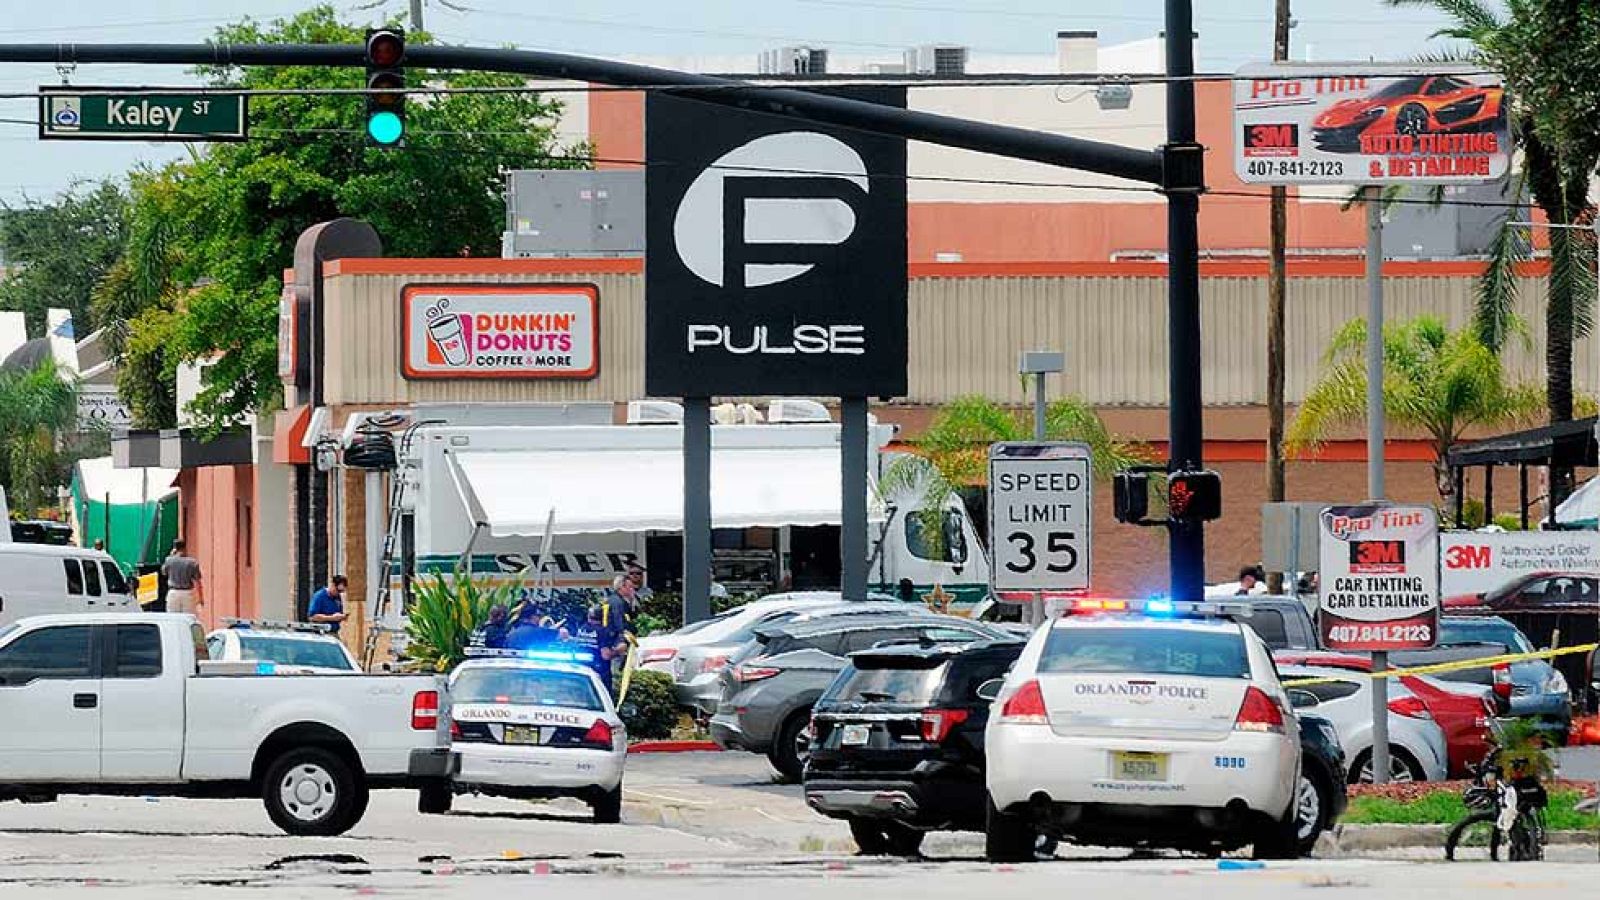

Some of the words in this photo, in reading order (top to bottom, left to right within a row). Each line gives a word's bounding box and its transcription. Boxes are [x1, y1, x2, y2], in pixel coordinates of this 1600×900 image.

[1251, 79, 1300, 98] Pro
[1315, 77, 1367, 94] Tint
[107, 99, 183, 131] Kaley
[192, 100, 210, 115] ST
[1251, 125, 1293, 147] 3M
[1360, 134, 1414, 154] AUTO
[1418, 134, 1498, 153] TINTING
[1248, 161, 1343, 176] 407-841-2123
[1369, 160, 1384, 177] &
[1388, 157, 1490, 176] DETAILING
[476, 314, 576, 331] DUNKIN'
[477, 334, 572, 351] DONUTS
[688, 324, 865, 354] PULSE
[476, 356, 523, 366] COFFEE
[535, 356, 571, 366] MORE
[1000, 473, 1081, 491] SPEED
[1009, 504, 1072, 522] LIMIT
[1333, 517, 1372, 533] Pro
[1382, 511, 1424, 529] Tint
[1006, 531, 1077, 573] 35
[1357, 542, 1400, 563] 3M
[1446, 545, 1491, 568] 3M
[1335, 577, 1363, 592] CAR
[1367, 577, 1422, 592] TINTING
[1328, 593, 1355, 608] CAR
[1359, 593, 1429, 607] DETAILING
[1328, 625, 1431, 642] 407.841.2123
[1075, 683, 1151, 695] ORLANDO
[1158, 686, 1208, 699] POLICE
[462, 709, 511, 718] ORLANDO
[534, 711, 581, 724] POLICE
